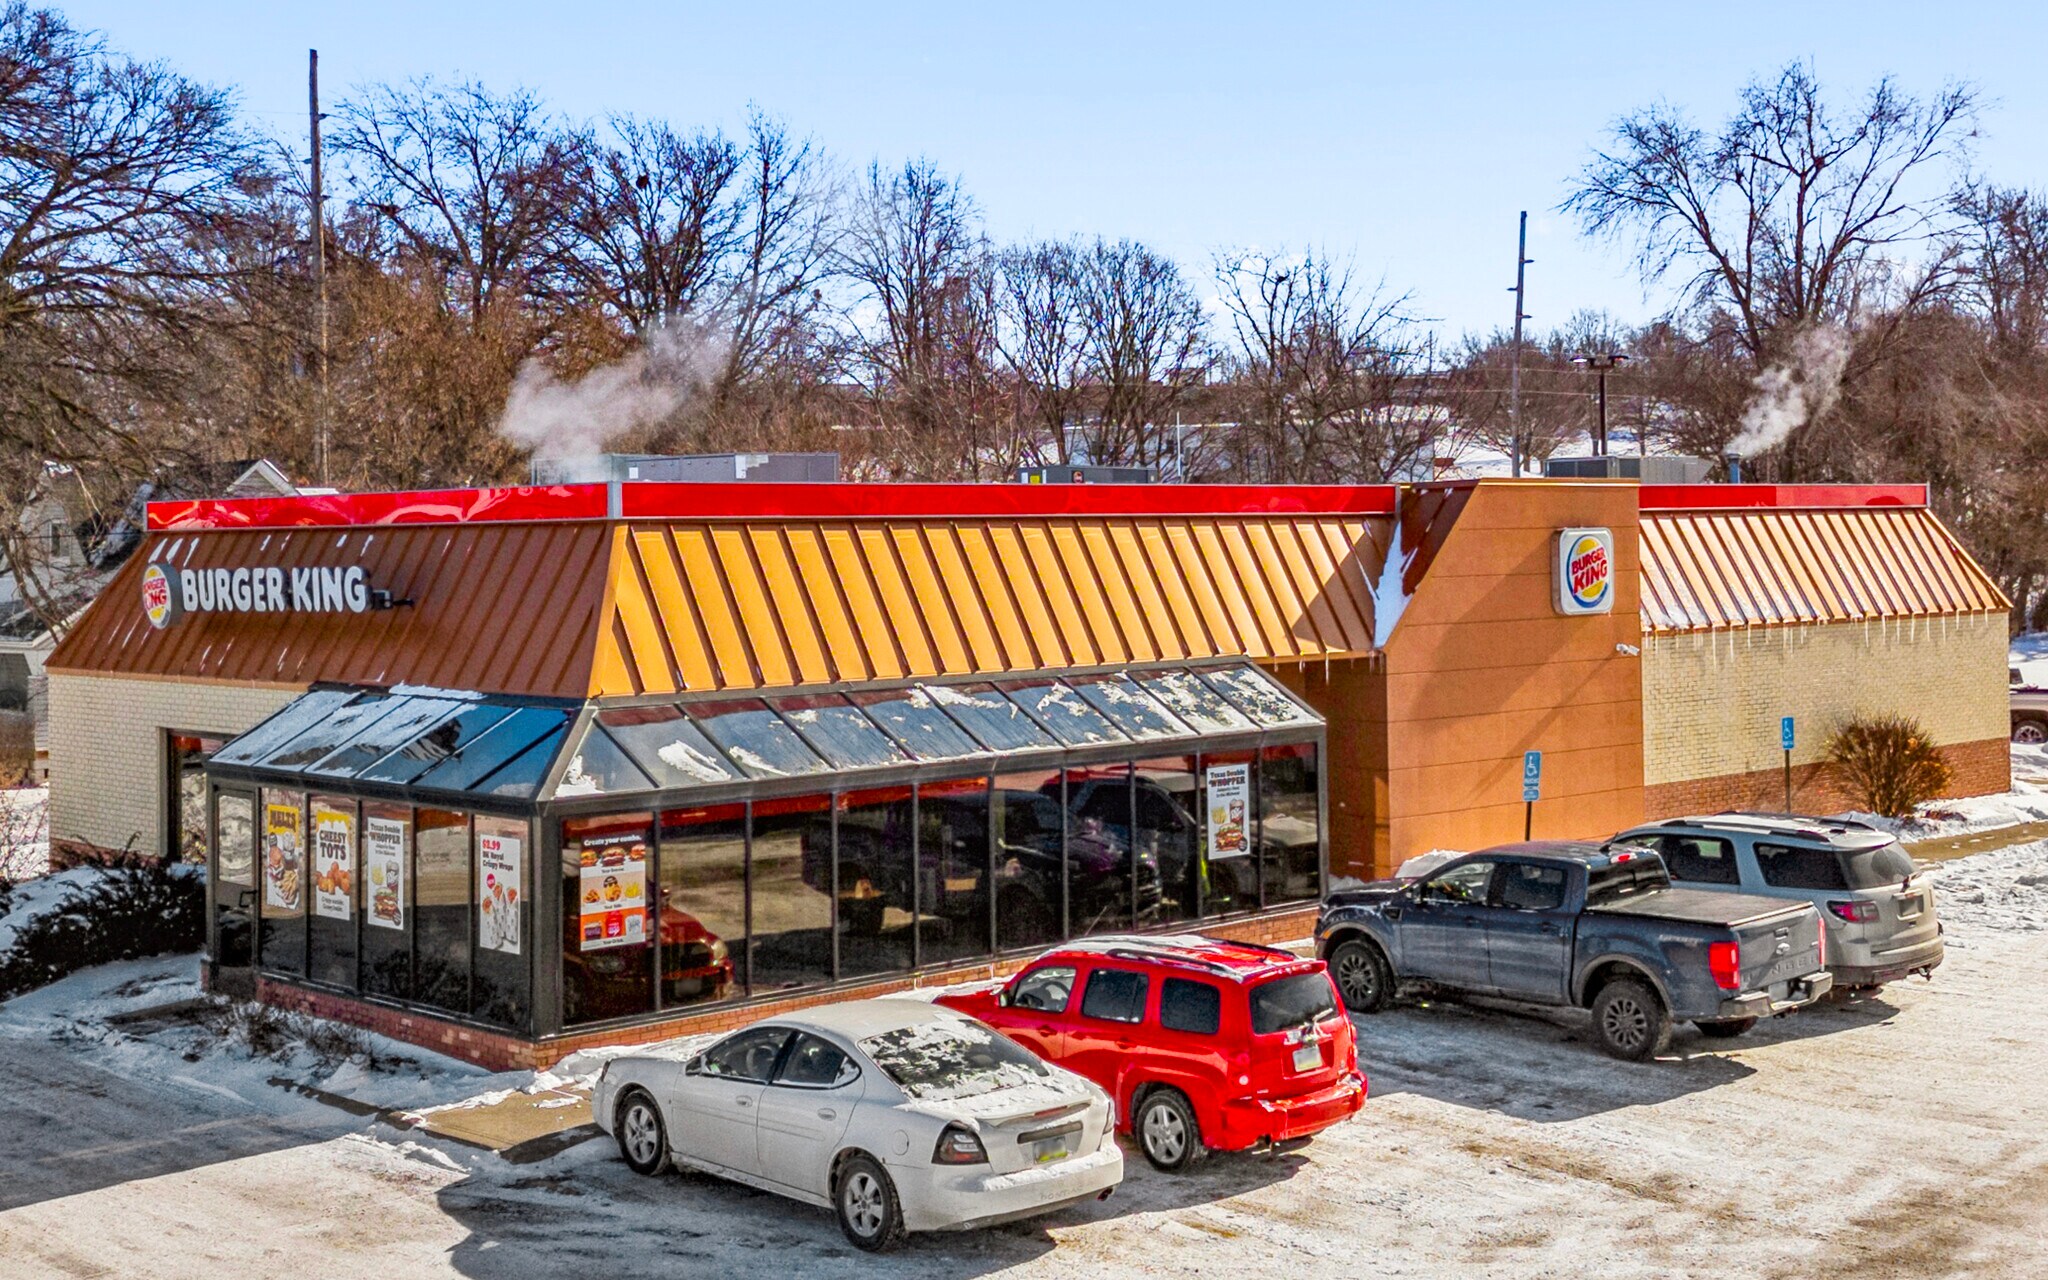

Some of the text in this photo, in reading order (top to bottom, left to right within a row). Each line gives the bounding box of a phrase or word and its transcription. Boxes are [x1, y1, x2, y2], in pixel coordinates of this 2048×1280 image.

[1573, 559, 1608, 594] KING
[181, 566, 366, 613] BURGER KING
[1227, 769, 1245, 777] Double
[1209, 777, 1245, 787] WHOPPER
[319, 830, 347, 845] CHEESY
[368, 831, 402, 845] WHOPPER
[319, 842, 347, 861] TOTS
